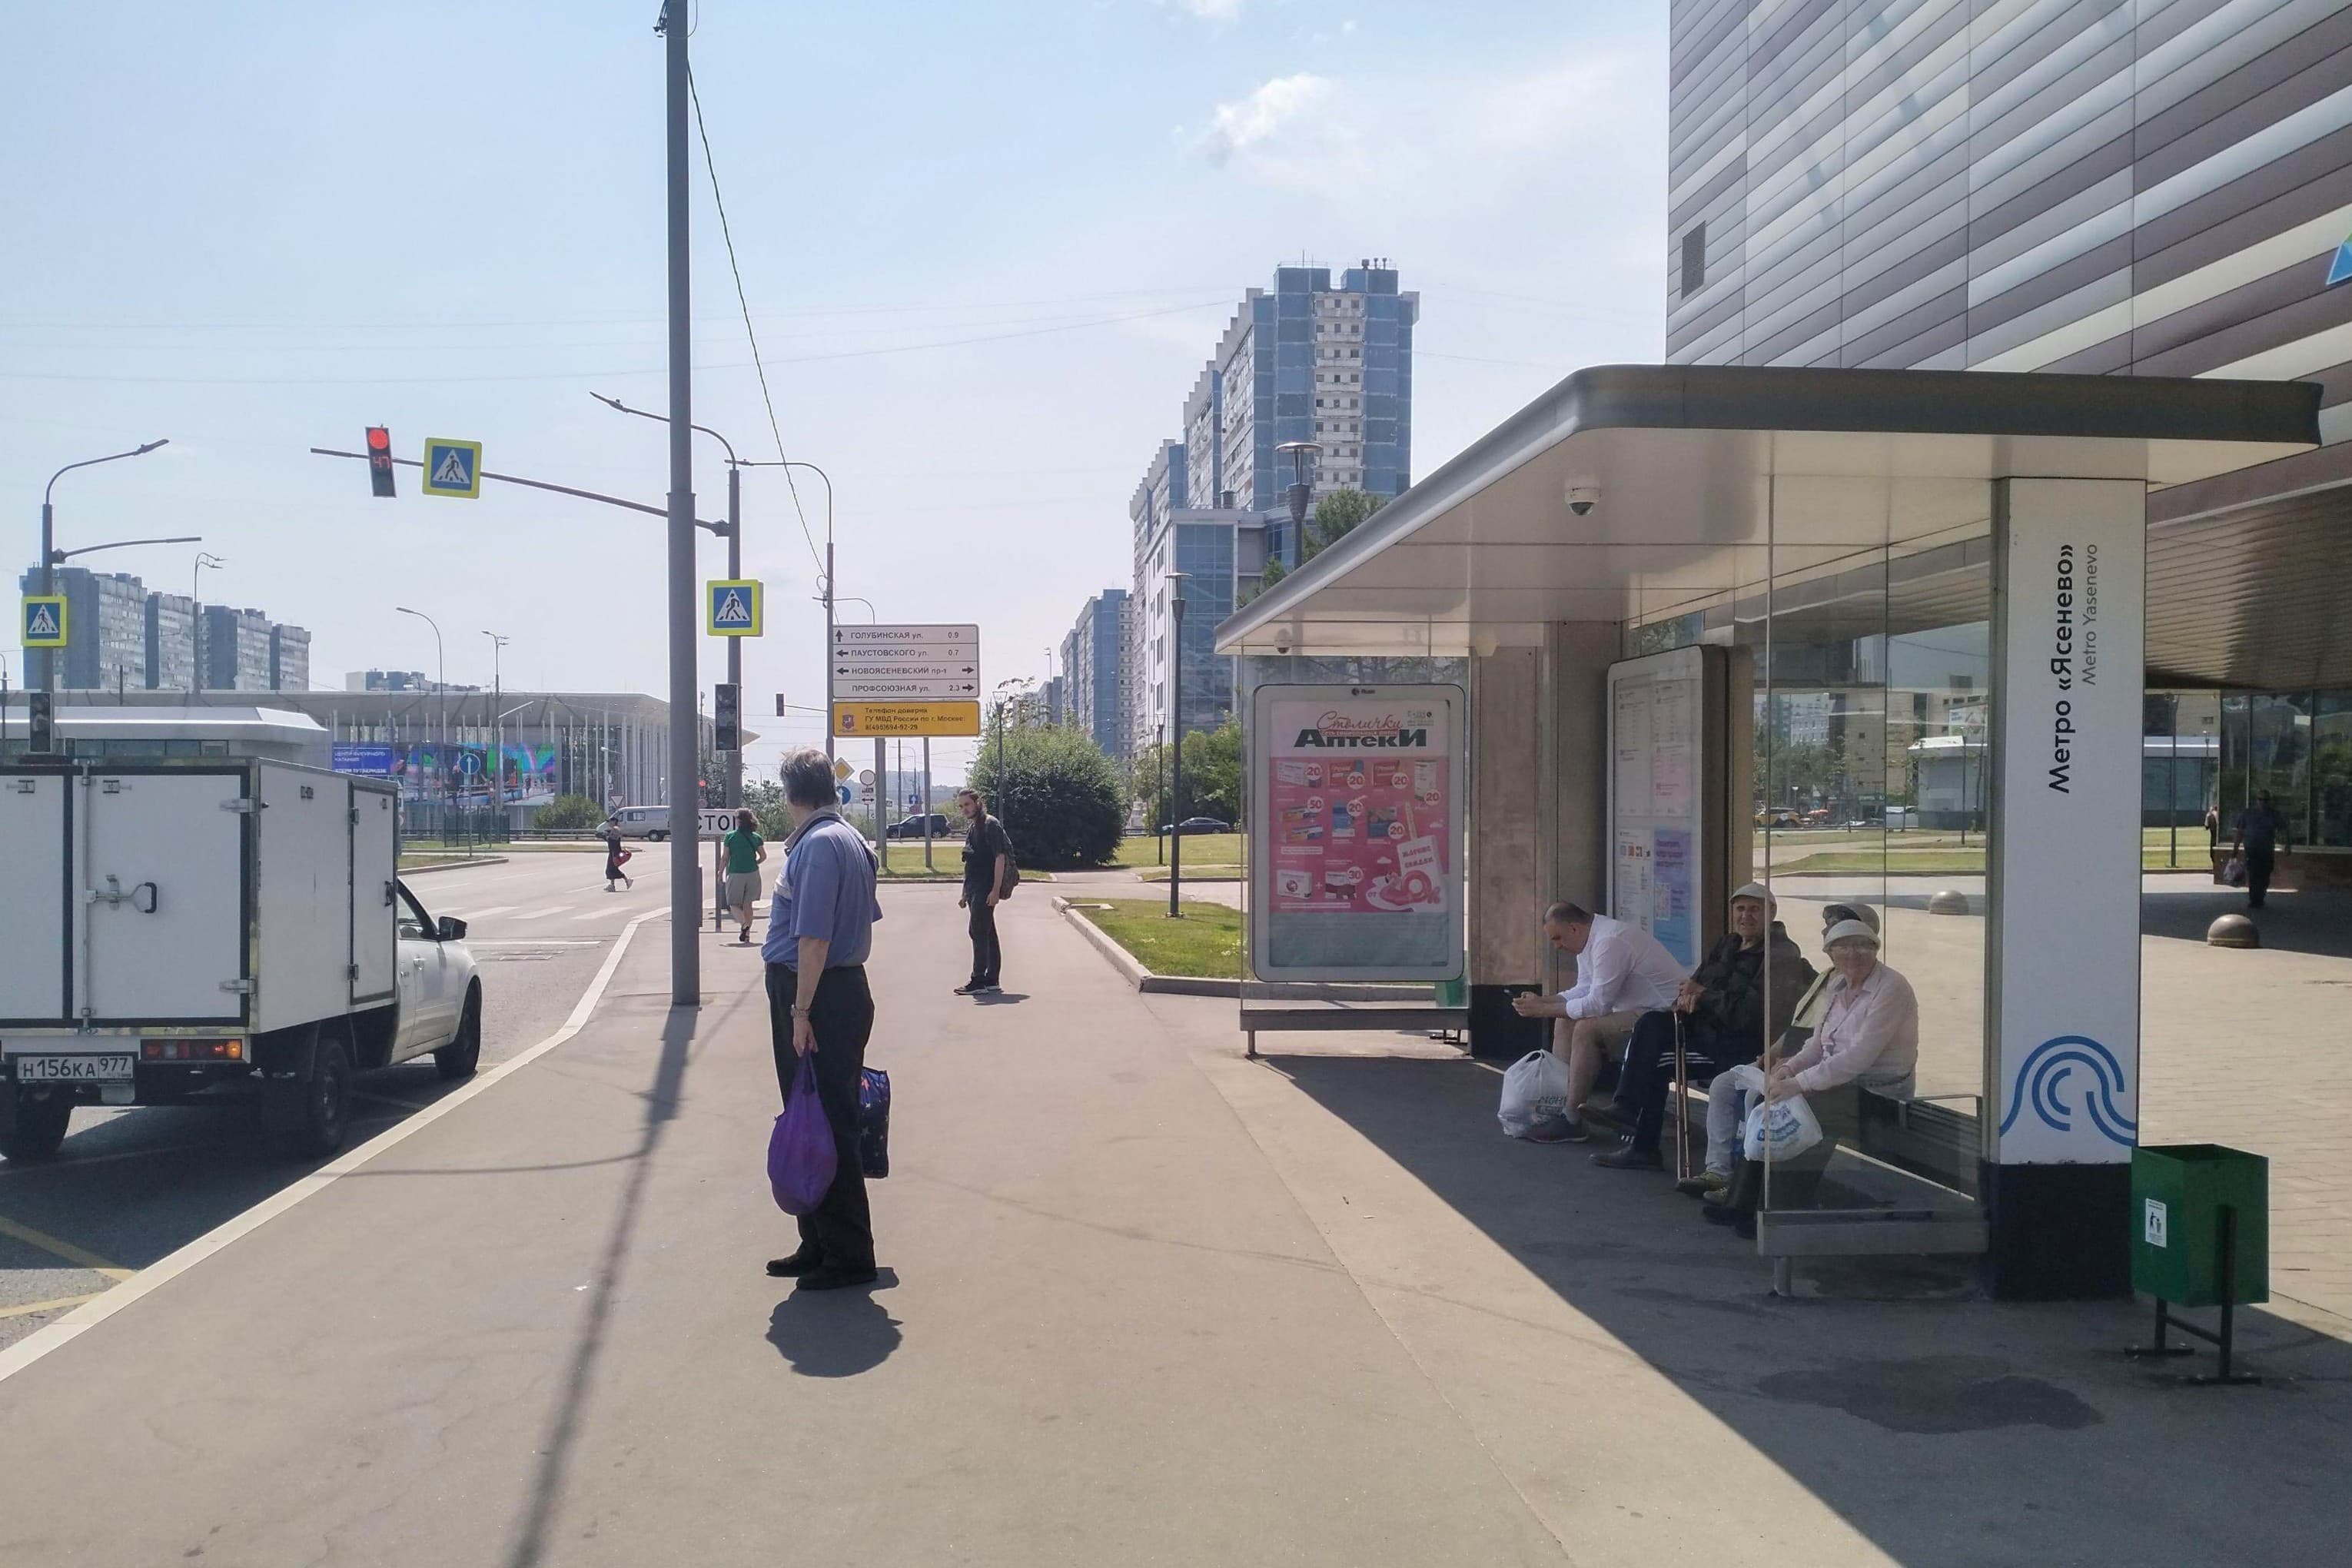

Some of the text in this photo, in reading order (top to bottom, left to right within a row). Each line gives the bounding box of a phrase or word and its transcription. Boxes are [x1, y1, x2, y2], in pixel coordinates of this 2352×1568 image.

[2081, 543, 2098, 686] Metro Yasenevo
[850, 649, 916, 657] ПАУСТОВСКОГО
[851, 666, 947, 676] НОВОЯСЕНЕВСКИЙ пр-т
[2048, 543, 2076, 794] Метро «Ясенево»
[698, 815, 736, 831] ТО
